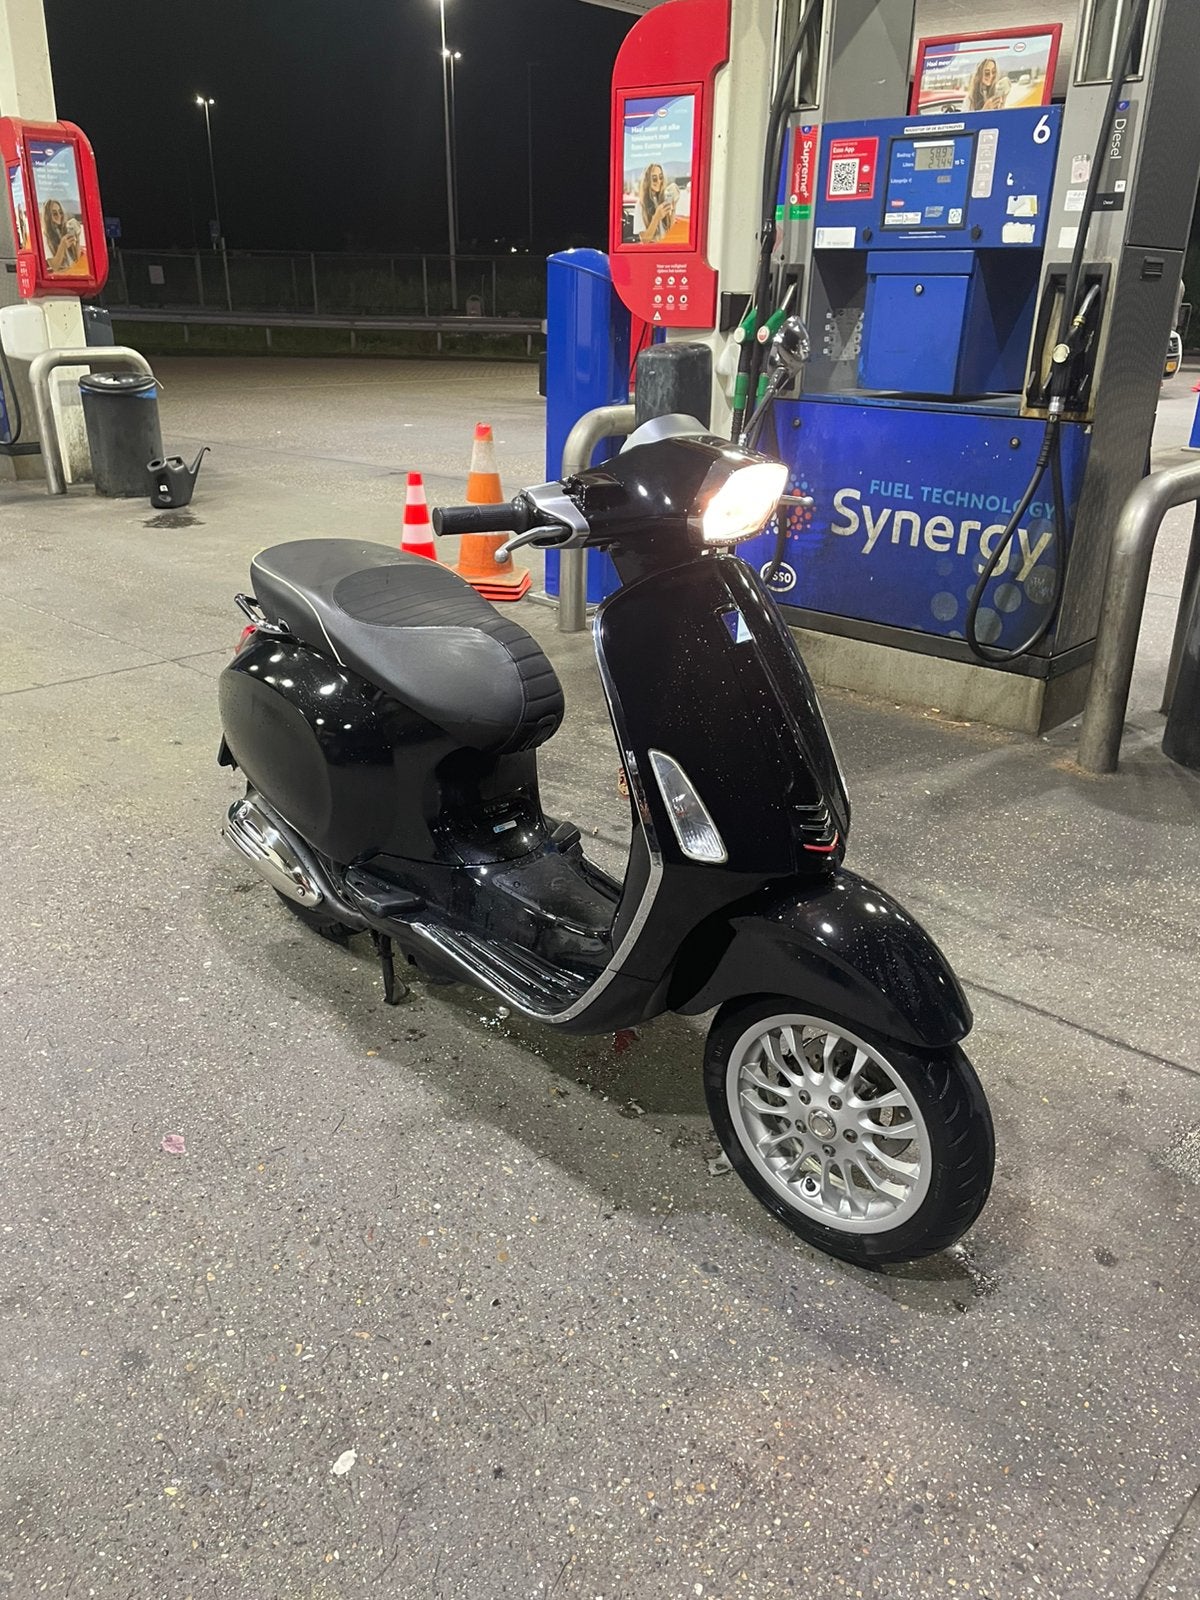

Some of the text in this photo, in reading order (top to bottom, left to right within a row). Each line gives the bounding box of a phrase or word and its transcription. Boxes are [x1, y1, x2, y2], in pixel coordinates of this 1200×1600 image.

[1033, 114, 1051, 144] 6
[1110, 118, 1127, 159] Diesel
[869, 479, 914, 500] FUEL
[831, 487, 1053, 582] Synergy
